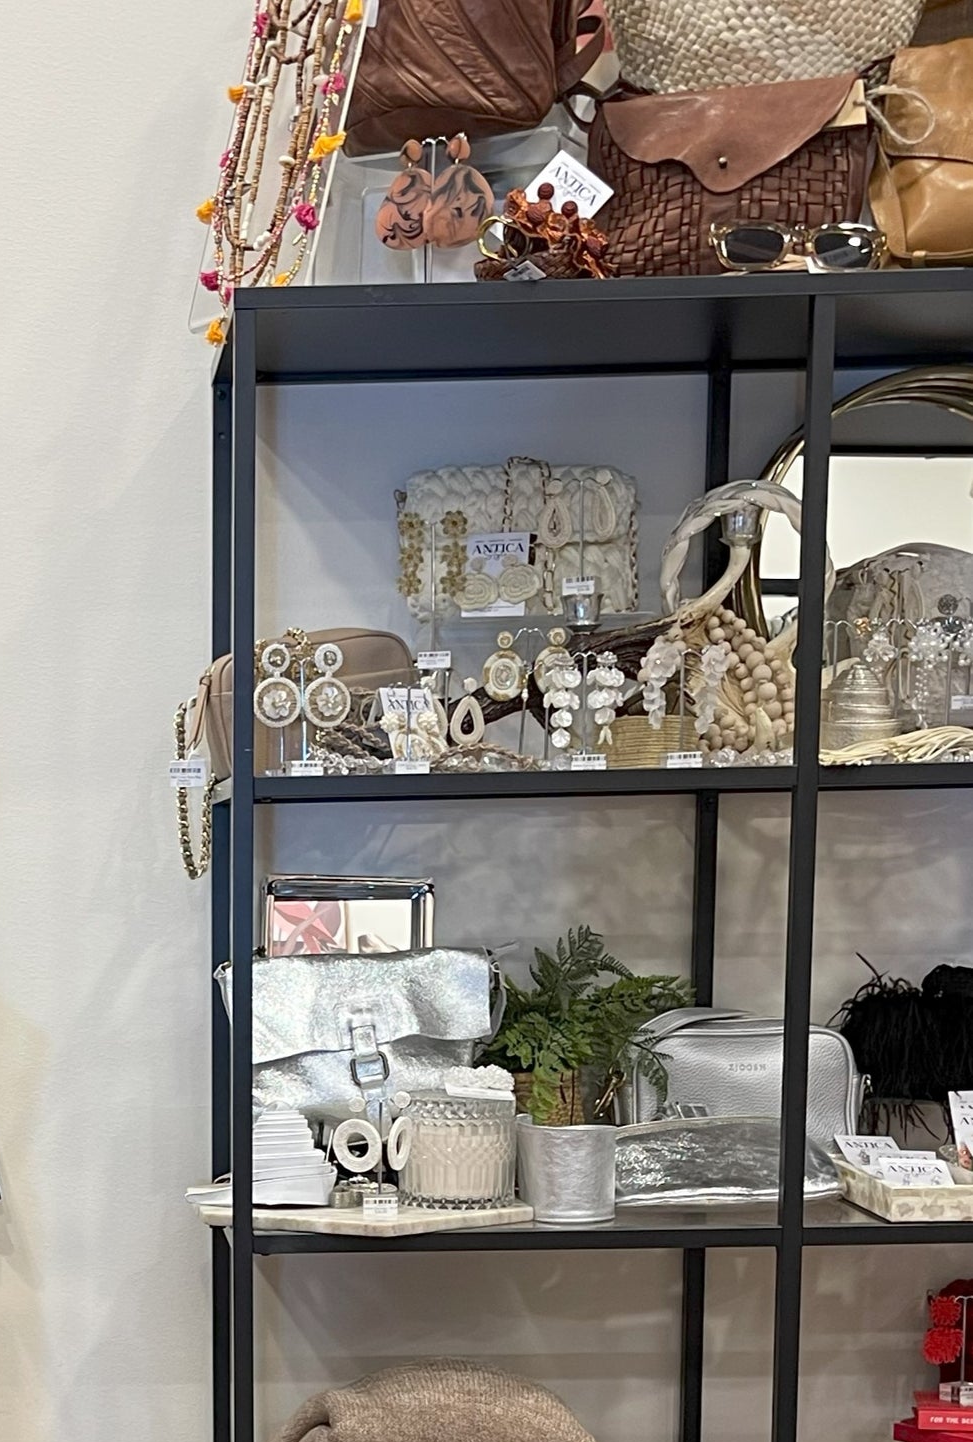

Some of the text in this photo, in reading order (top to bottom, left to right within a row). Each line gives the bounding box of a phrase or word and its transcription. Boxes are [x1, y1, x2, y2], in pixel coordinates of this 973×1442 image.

[549, 166, 596, 206] ANTICA
[472, 542, 524, 555] ANTICA
[842, 1141, 894, 1149] ANTICA
[888, 1164, 943, 1174] ANTICA
